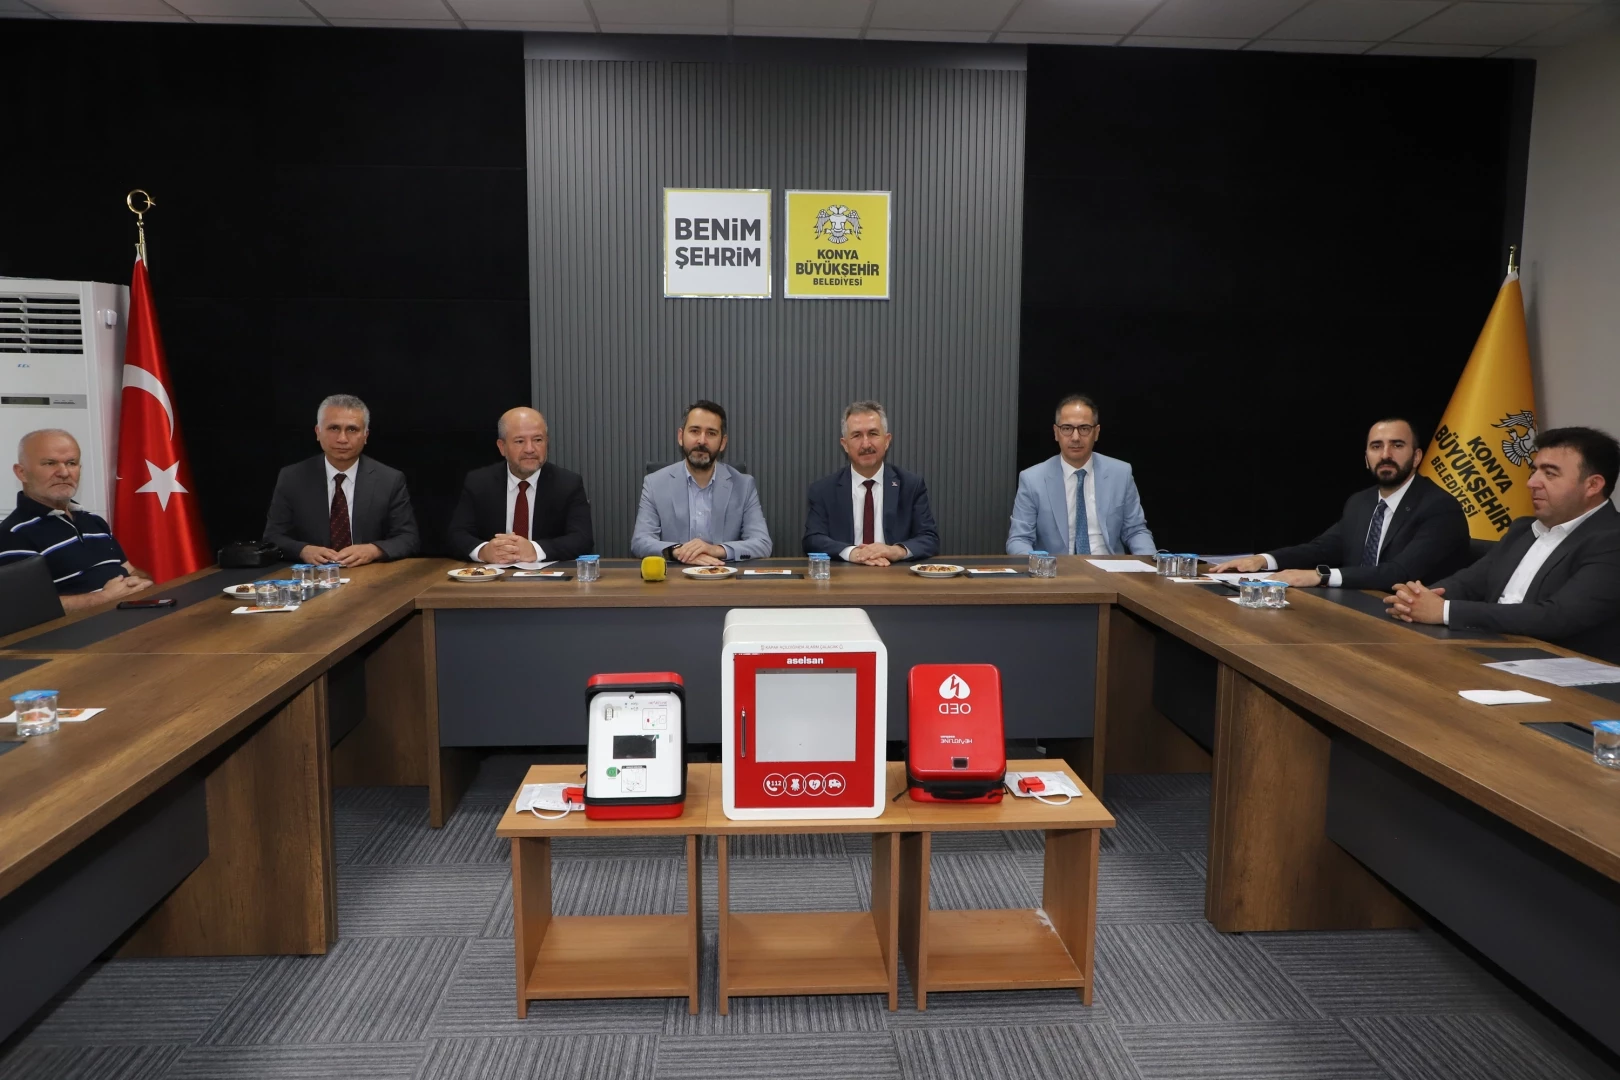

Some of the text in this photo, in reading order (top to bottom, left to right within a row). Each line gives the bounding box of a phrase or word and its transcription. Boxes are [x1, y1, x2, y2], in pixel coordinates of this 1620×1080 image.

[817, 249, 859, 260] KONYA
[795, 260, 880, 277] BÜYÜKŞEHİR
[813, 277, 863, 286] BELEDİYESİ
[1466, 435, 1513, 494] KONYA
[1434, 424, 1513, 533] BÜYÜKŞEHİR
[1430, 455, 1481, 518] BELEDİYESİ
[786, 655, 824, 665] aselsan
[938, 703, 972, 714] OED
